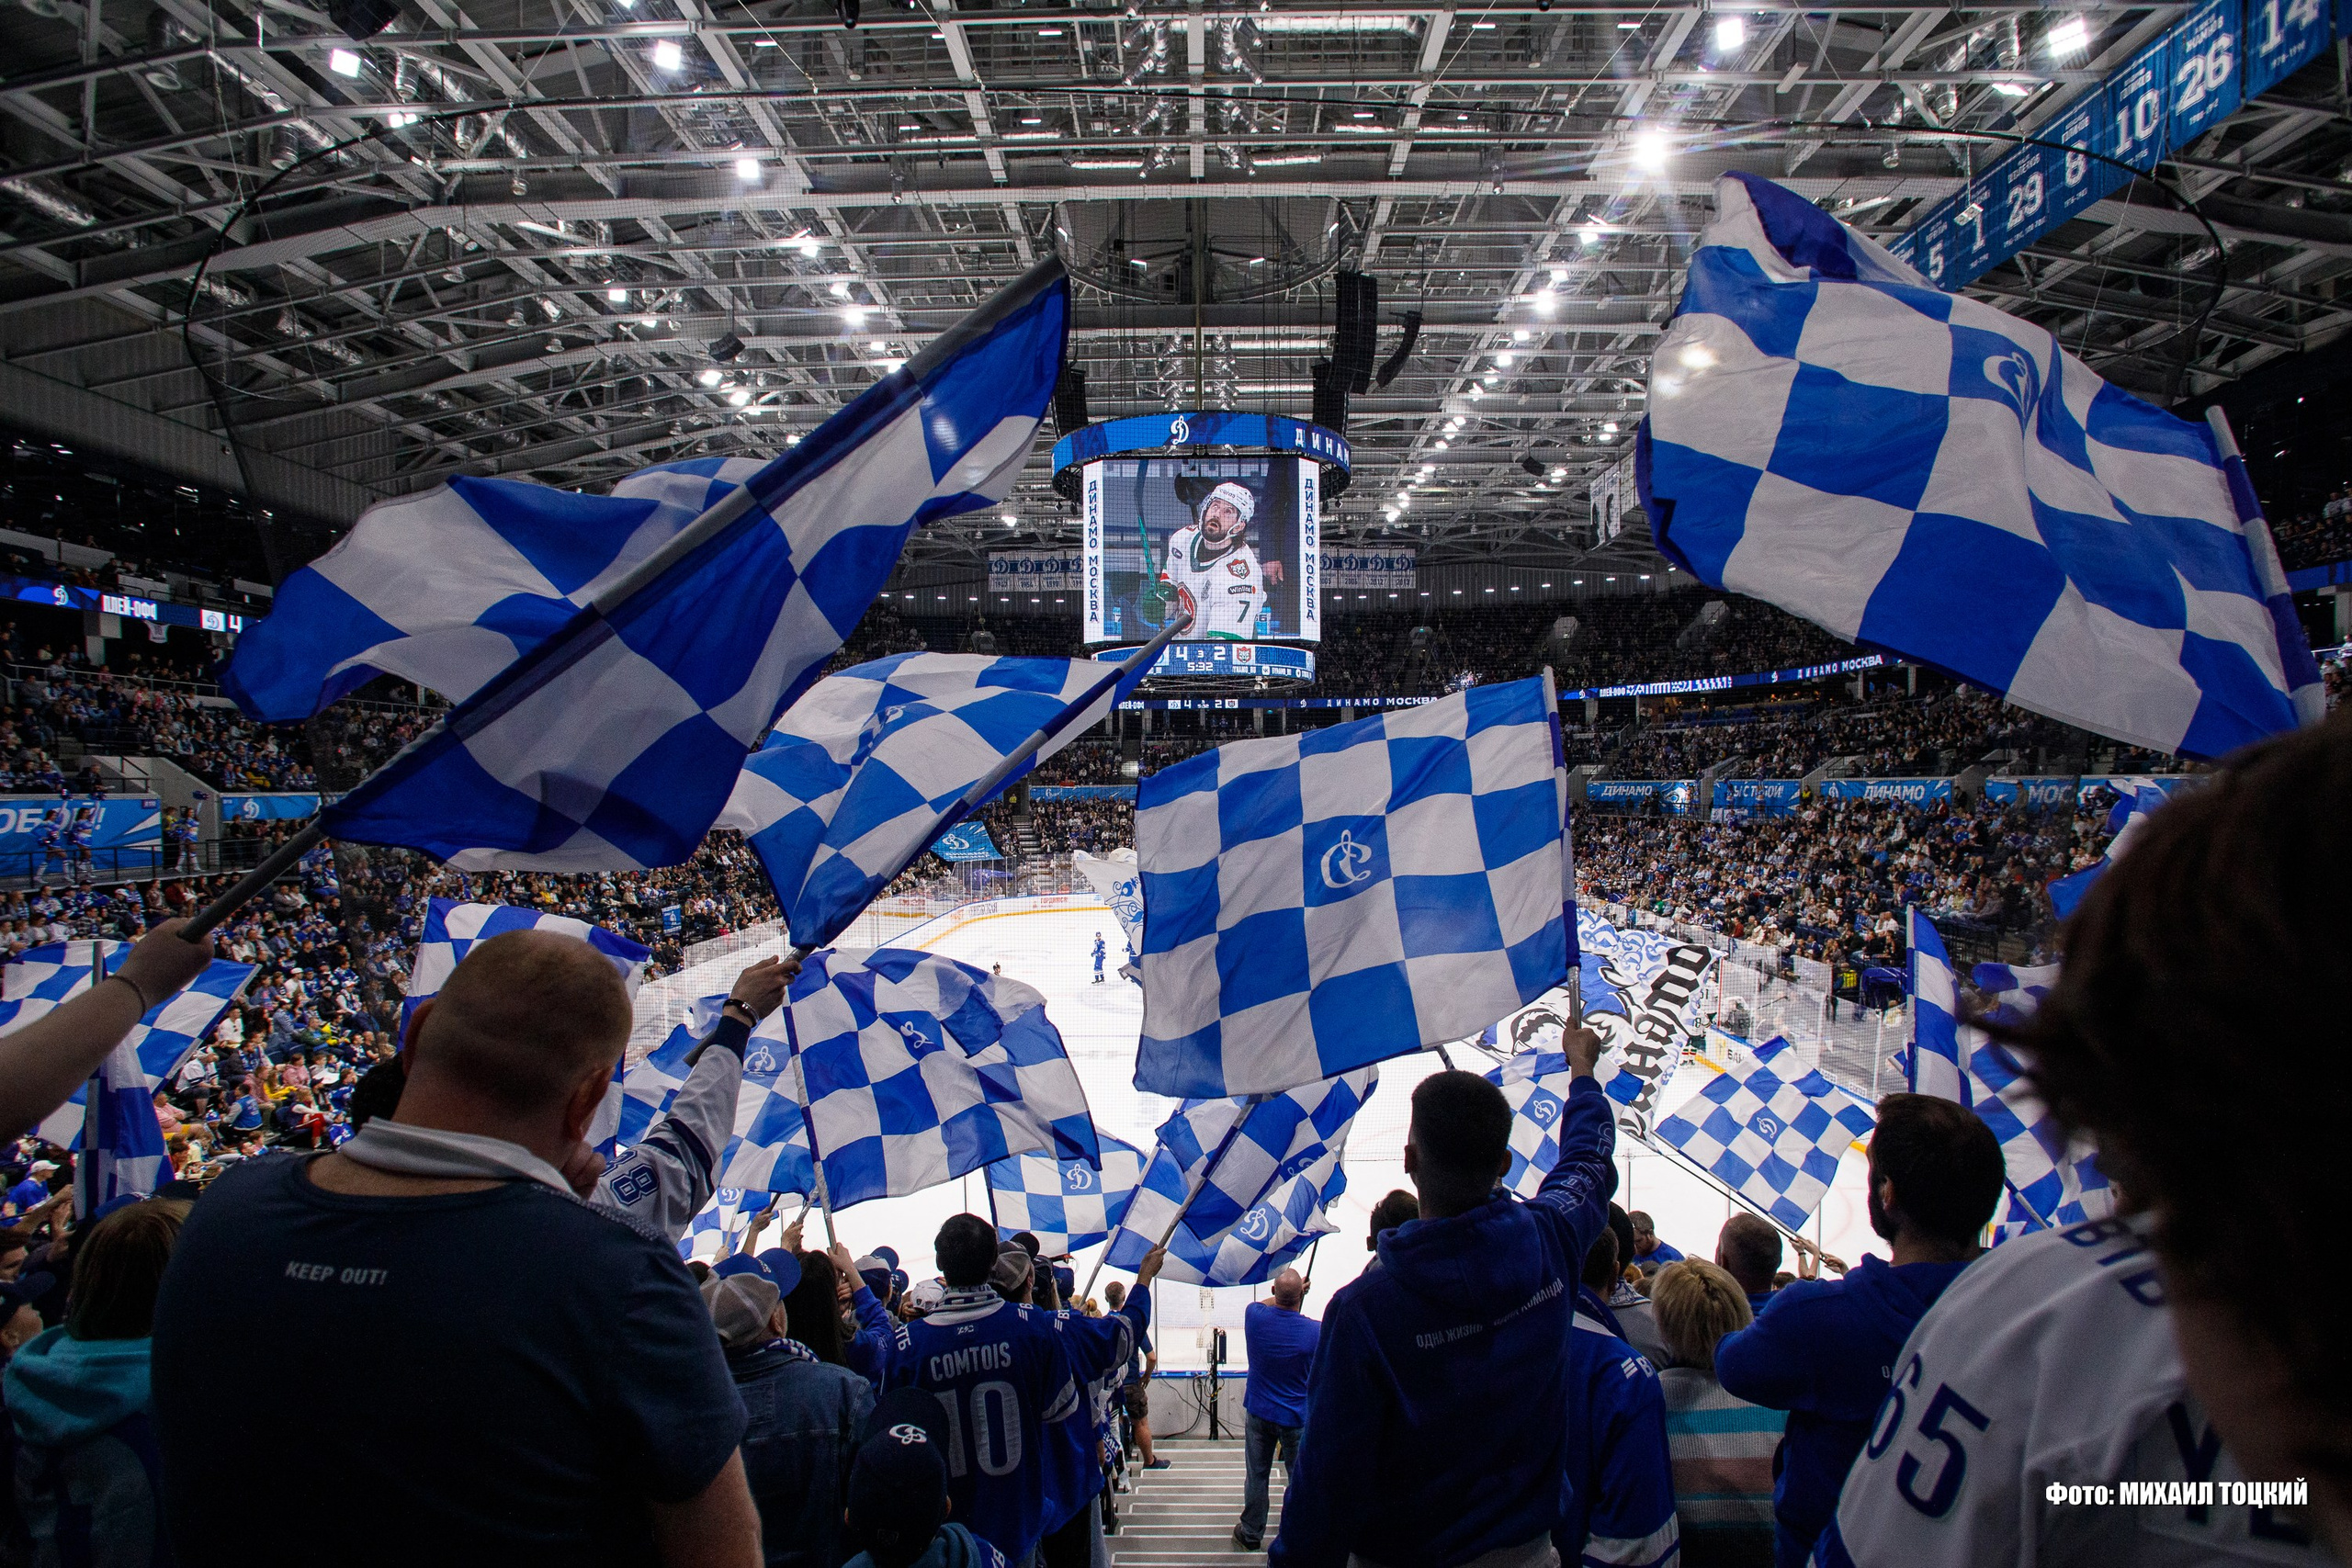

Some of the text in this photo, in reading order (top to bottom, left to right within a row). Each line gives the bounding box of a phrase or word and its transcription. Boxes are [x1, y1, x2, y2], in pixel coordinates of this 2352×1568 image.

[2259, 0, 2320, 58] 14
[2176, 33, 2234, 117] 26
[2115, 87, 2160, 160] 10
[2065, 140, 2087, 187] 8
[2007, 172, 2044, 231] 29
[1972, 213, 1986, 254] 1
[1929, 240, 1944, 281] 5
[1088, 479, 1100, 622] ДИНАМО МОСКВА
[1304, 478, 1316, 621] ДИНАМО МОСКВА
[229, 614, 243, 633] 4
[1237, 600, 1250, 623] 7
[1176, 646, 1188, 660] 4
[1187, 661, 1214, 671] 5:32
[1197, 649, 1204, 658] 3
[1214, 646, 1226, 660] 2
[1797, 654, 1883, 680] ДИНАМО МОСКВА
[1183, 699, 1192, 709] 4
[1215, 699, 1222, 708] 2
[1327, 696, 1438, 708] ДИНАМО МОСКВА
[1600, 784, 1653, 797] ДИНАМО
[1863, 784, 1926, 802] ДИНАМО
[284, 1259, 389, 1286] KEEP OUT!
[1415, 1331, 1445, 1350] ОДНА
[930, 1340, 1012, 1382] COMTOIS
[933, 1380, 1023, 1478] 10
[1867, 1351, 1991, 1519] 65
